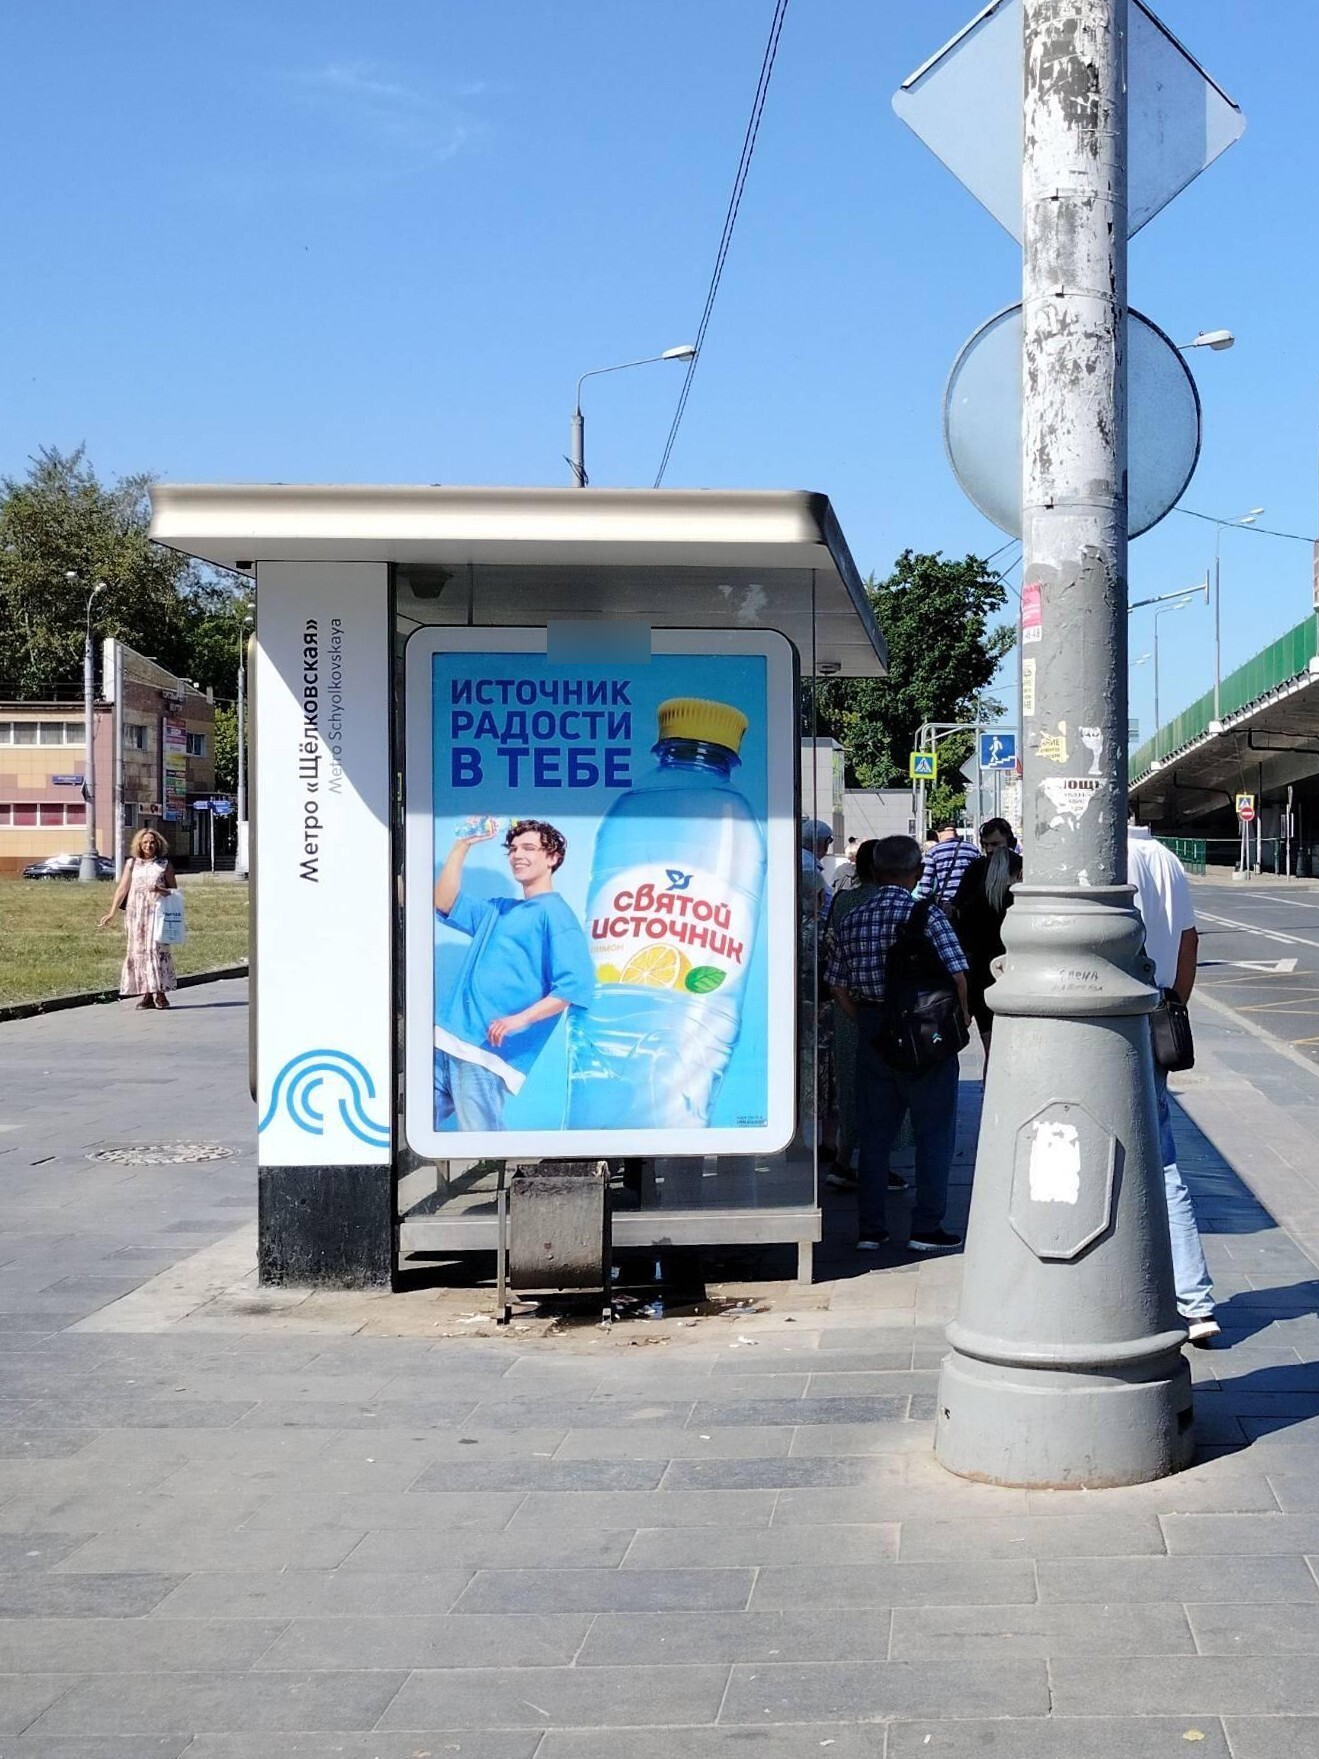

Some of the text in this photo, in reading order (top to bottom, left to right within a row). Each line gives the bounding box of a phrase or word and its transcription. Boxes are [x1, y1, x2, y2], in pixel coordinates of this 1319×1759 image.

[327, 618, 344, 794] Metro Schyolkovskaya
[451, 678, 632, 706] ИСТОЧНИК
[451, 710, 632, 745] РАДОСТИ
[299, 618, 323, 883] Метро «Щёлковская»
[451, 747, 632, 788] В ТЕБЕ
